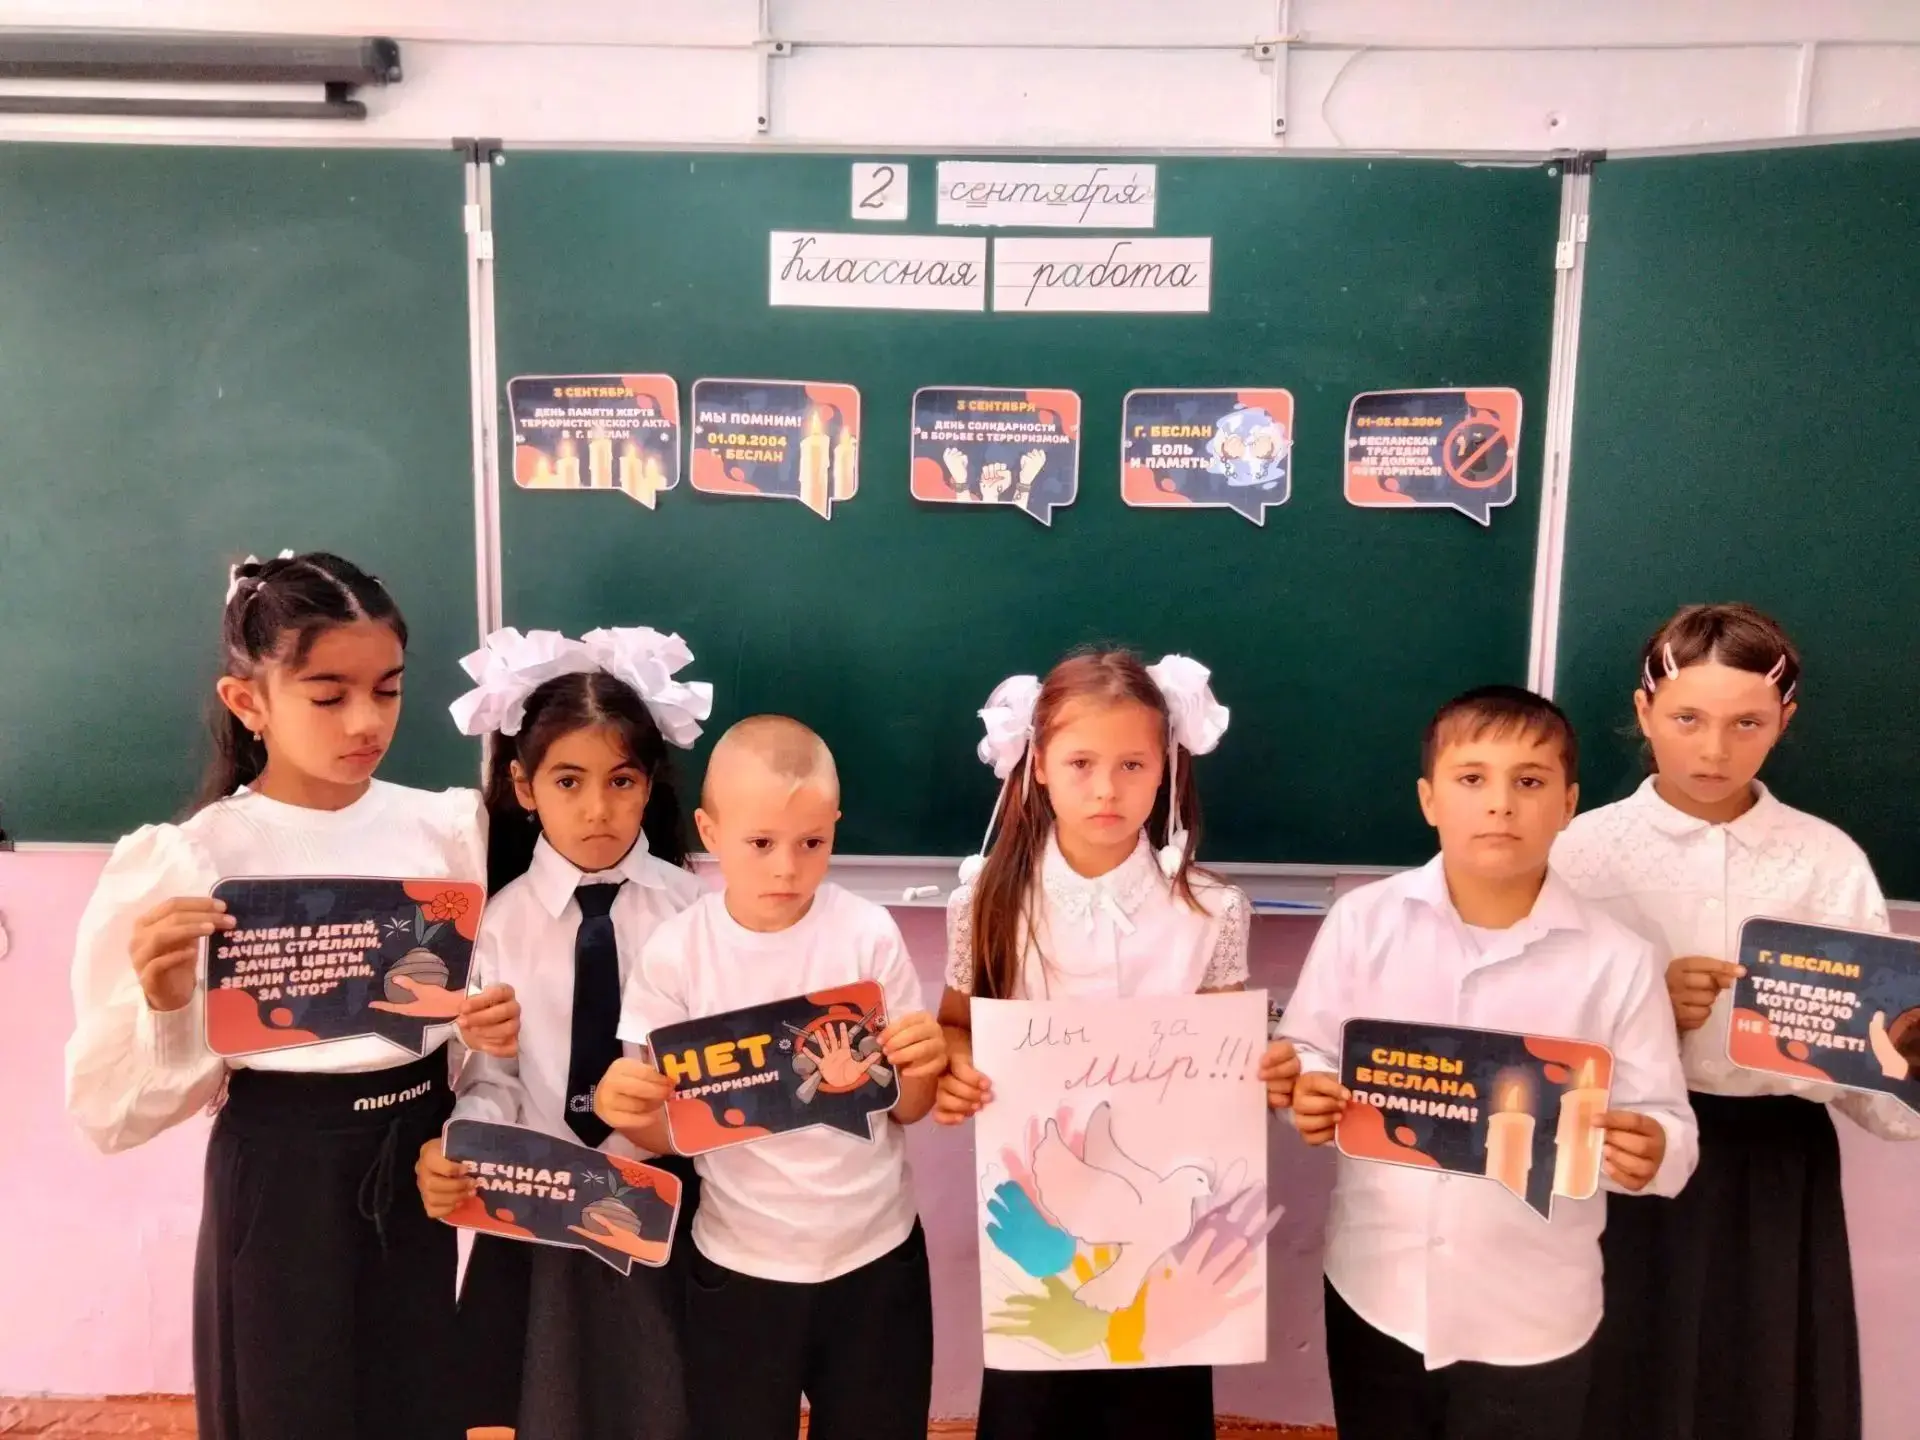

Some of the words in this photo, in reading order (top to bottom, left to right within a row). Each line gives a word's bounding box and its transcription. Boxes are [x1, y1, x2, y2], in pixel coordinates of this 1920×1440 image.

[859, 165, 895, 209] 2
[780, 237, 978, 288] Классная
[1024, 241, 1198, 308] работа
[565, 387, 634, 398] СЕНТЯБРЯ
[534, 408, 566, 418] ДЕНЬ
[568, 407, 614, 417] ПАМЯТИ
[616, 407, 655, 417] ЖЕРТВ
[957, 400, 965, 411] 3
[968, 400, 1036, 412] СЕНТЯБРЯ
[642, 418, 671, 428] АКТА
[700, 411, 726, 424] МЫ
[731, 412, 802, 427] ПОМНИМ!
[934, 420, 965, 431] ДЕНЬ
[968, 421, 1056, 433] СОЛИДАРНОСТИ
[707, 432, 788, 448] 01.09.2004
[931, 432, 974, 442] БОРЬБЕ
[976, 433, 984, 442] С
[986, 432, 1070, 444] ТЕРРОРИЗМОМ
[1134, 425, 1147, 438] Г.
[1150, 425, 1213, 438] БЕСЛАН
[1359, 436, 1438, 446] БЕСЛАНСКАЯ
[726, 449, 783, 463] БЕСЛАН
[1151, 443, 1194, 456] БОЛЬ
[1366, 446, 1429, 456] ТРАГЕДИЯ
[1130, 457, 1141, 469] И
[300, 925, 313, 938] В
[316, 919, 380, 939] ДЕТЕЙ,
[217, 943, 281, 960] ЗАЧЕМ
[285, 935, 383, 954] СТРЕЛЯЛИ,
[234, 956, 297, 973] ЗАЧЕМ
[302, 950, 364, 968] ЦВЕТЫ
[1758, 949, 1775, 965] Г.
[1779, 953, 1861, 979] БЕСЛАН
[220, 973, 285, 990] ЗЕМЛИ
[289, 964, 375, 985] СОРВАЛИ,
[258, 988, 282, 1001] ЗА
[1751, 976, 1862, 1008] ТРАГЕДИЯ,
[1755, 992, 1853, 1020] КОТОРУЮ
[1768, 1008, 1836, 1032] НИКТО
[1013, 1016, 1091, 1051] Мы
[1149, 1018, 1200, 1060] за
[1736, 1018, 1765, 1034] НЕ
[1768, 1023, 1866, 1053] ЗАБУДЕТ!
[662, 1033, 772, 1085] НЕТ
[1371, 1047, 1464, 1076] СЛЕЗЫ
[1355, 1066, 1477, 1099] БЕСЛАНА
[1351, 1089, 1479, 1123] ПОМНИМ!
[474, 1176, 577, 1202] АМЯТЬ!
